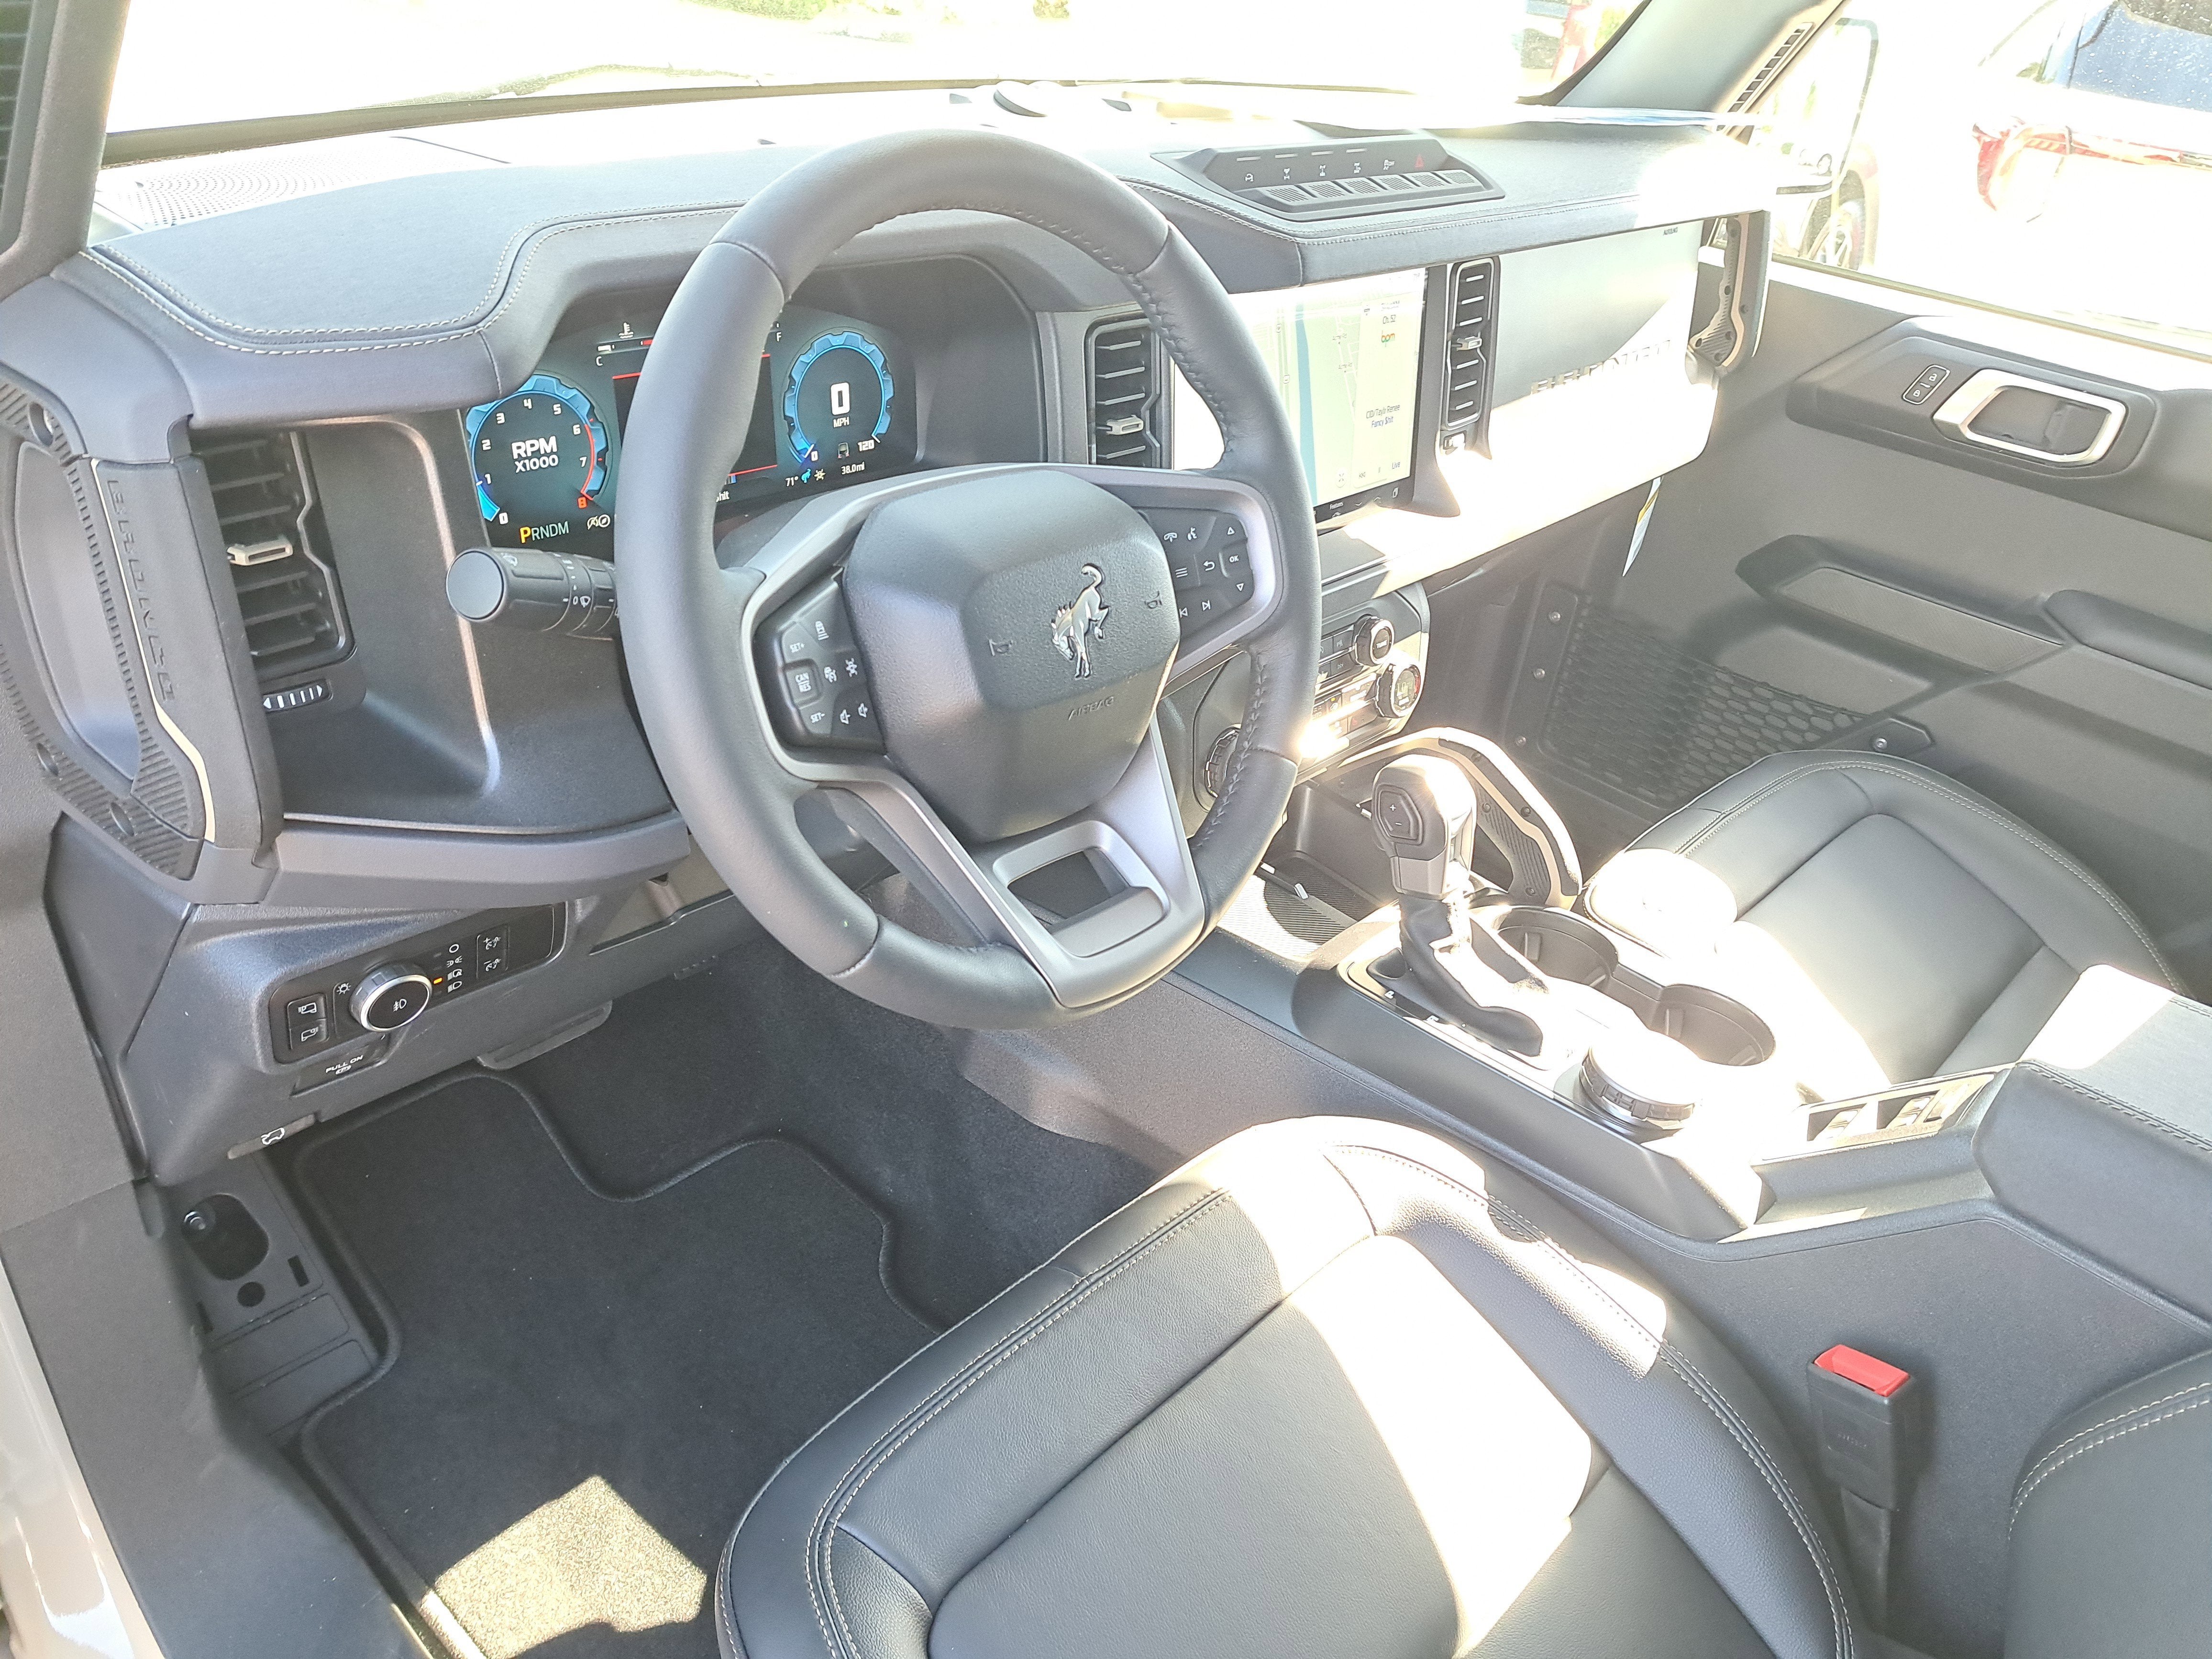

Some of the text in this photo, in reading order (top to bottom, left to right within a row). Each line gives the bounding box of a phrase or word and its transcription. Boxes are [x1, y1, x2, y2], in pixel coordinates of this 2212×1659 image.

[776, 332, 782, 342] F
[596, 357, 603, 366] C
[830, 382, 850, 415] 0
[524, 399, 531, 409] 4
[553, 404, 561, 415] 5
[497, 413, 505, 423] 3
[833, 417, 850, 428] MPH
[573, 425, 580, 435] 6
[482, 440, 491, 450] 2
[511, 436, 557, 459] RPM
[858, 440, 874, 451] 120
[811, 451, 818, 461] 0
[515, 455, 558, 473] X1000
[579, 457, 587, 467] 7
[485, 474, 491, 484] 1
[785, 476, 798, 487] 71°
[578, 498, 587, 508] 8
[499, 512, 508, 524] 0
[1068, 695, 1115, 720] AIRBAG
[350, 1055, 363, 1064] ON
